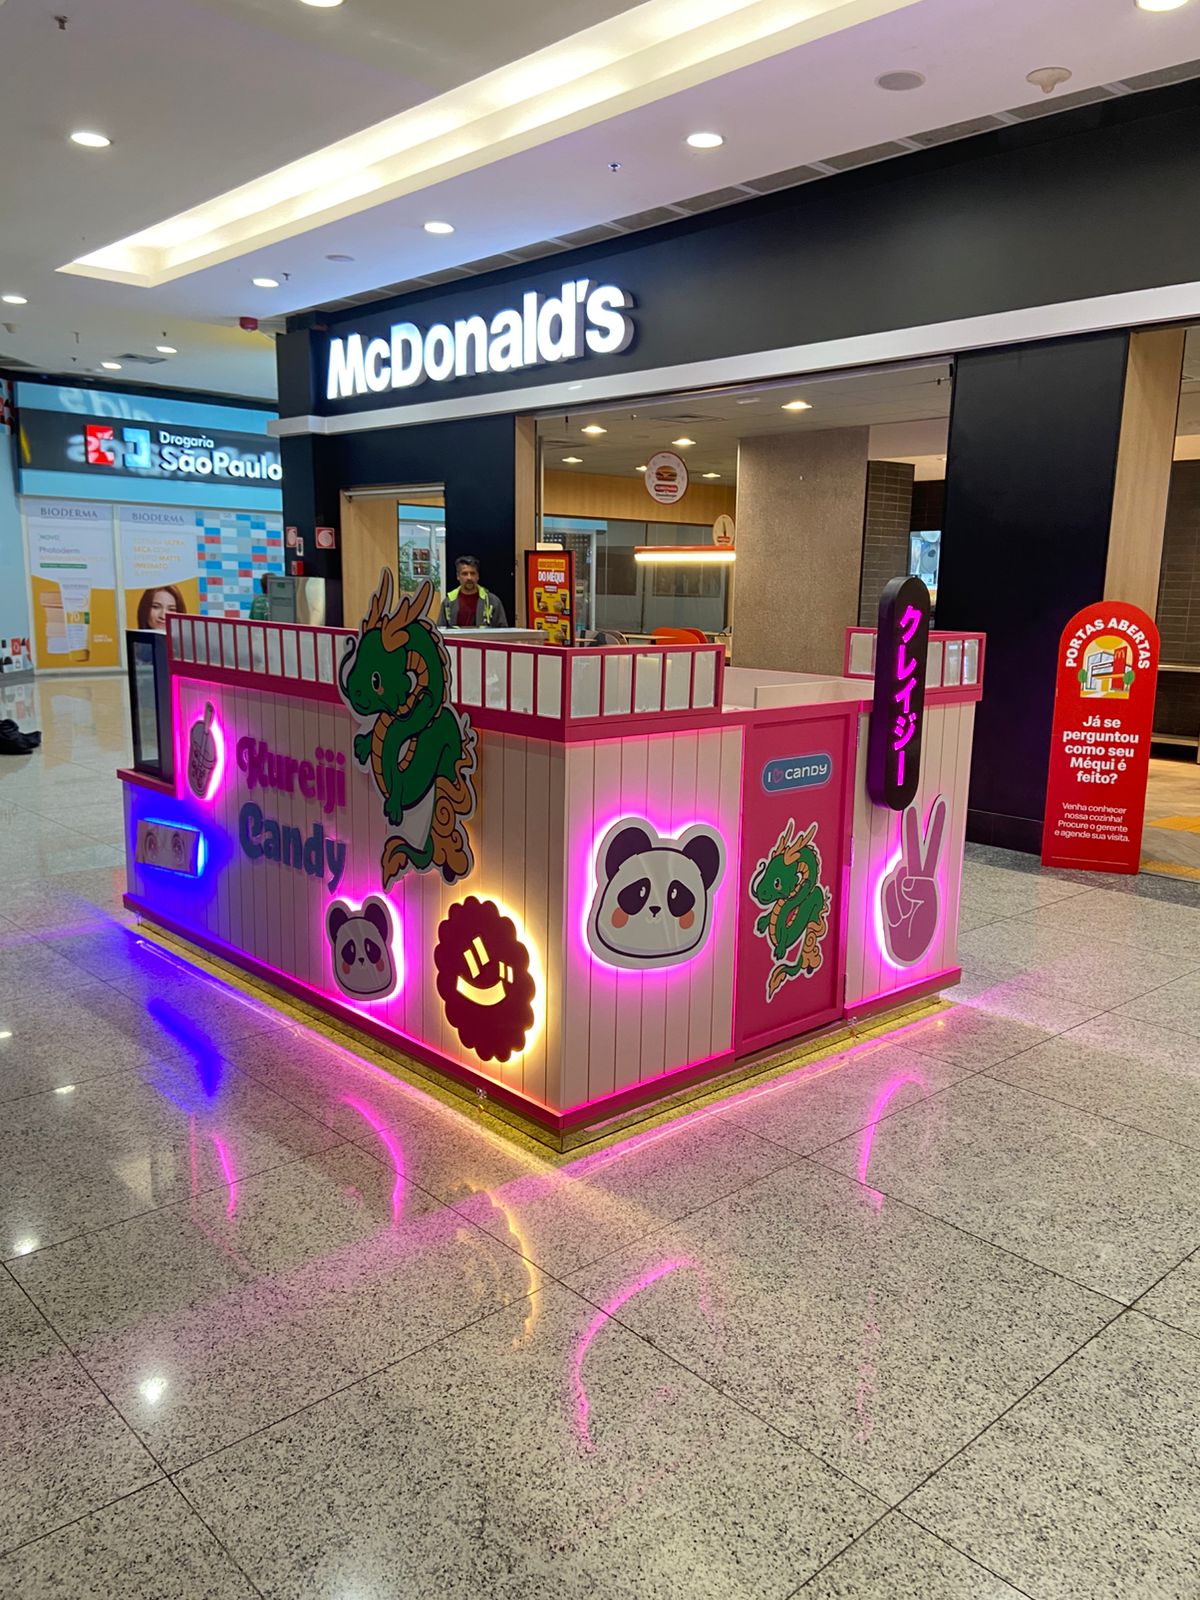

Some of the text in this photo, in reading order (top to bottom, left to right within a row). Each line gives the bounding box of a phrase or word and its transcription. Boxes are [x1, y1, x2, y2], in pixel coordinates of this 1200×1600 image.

[326, 278, 628, 400] McDonald's
[159, 430, 215, 449] Drogaria
[40, 506, 98, 519] BIODERMA
[132, 512, 185, 523] BIODERMA
[1065, 617, 1151, 669] PORTAS ABERTAS
[894, 604, 923, 786] クレイジー
[1082, 714, 1121, 728] Já se
[1062, 730, 1139, 743] perguntou
[1064, 745, 1135, 757] como seu
[1070, 756, 1127, 772] Méqui é
[236, 735, 346, 815] Kureiji
[767, 771, 771, 783] I
[1076, 770, 1118, 784] feito?
[1062, 801, 1127, 814] Venha conhecer
[1064, 811, 1088, 820] nossa
[1058, 819, 1089, 829] Procure
[1096, 823, 1128, 833] gerente
[1060, 829, 1091, 838] agende
[1091, 832, 1107, 840] sua
[1107, 832, 1130, 842] visita.
[238, 801, 347, 896] Candy
